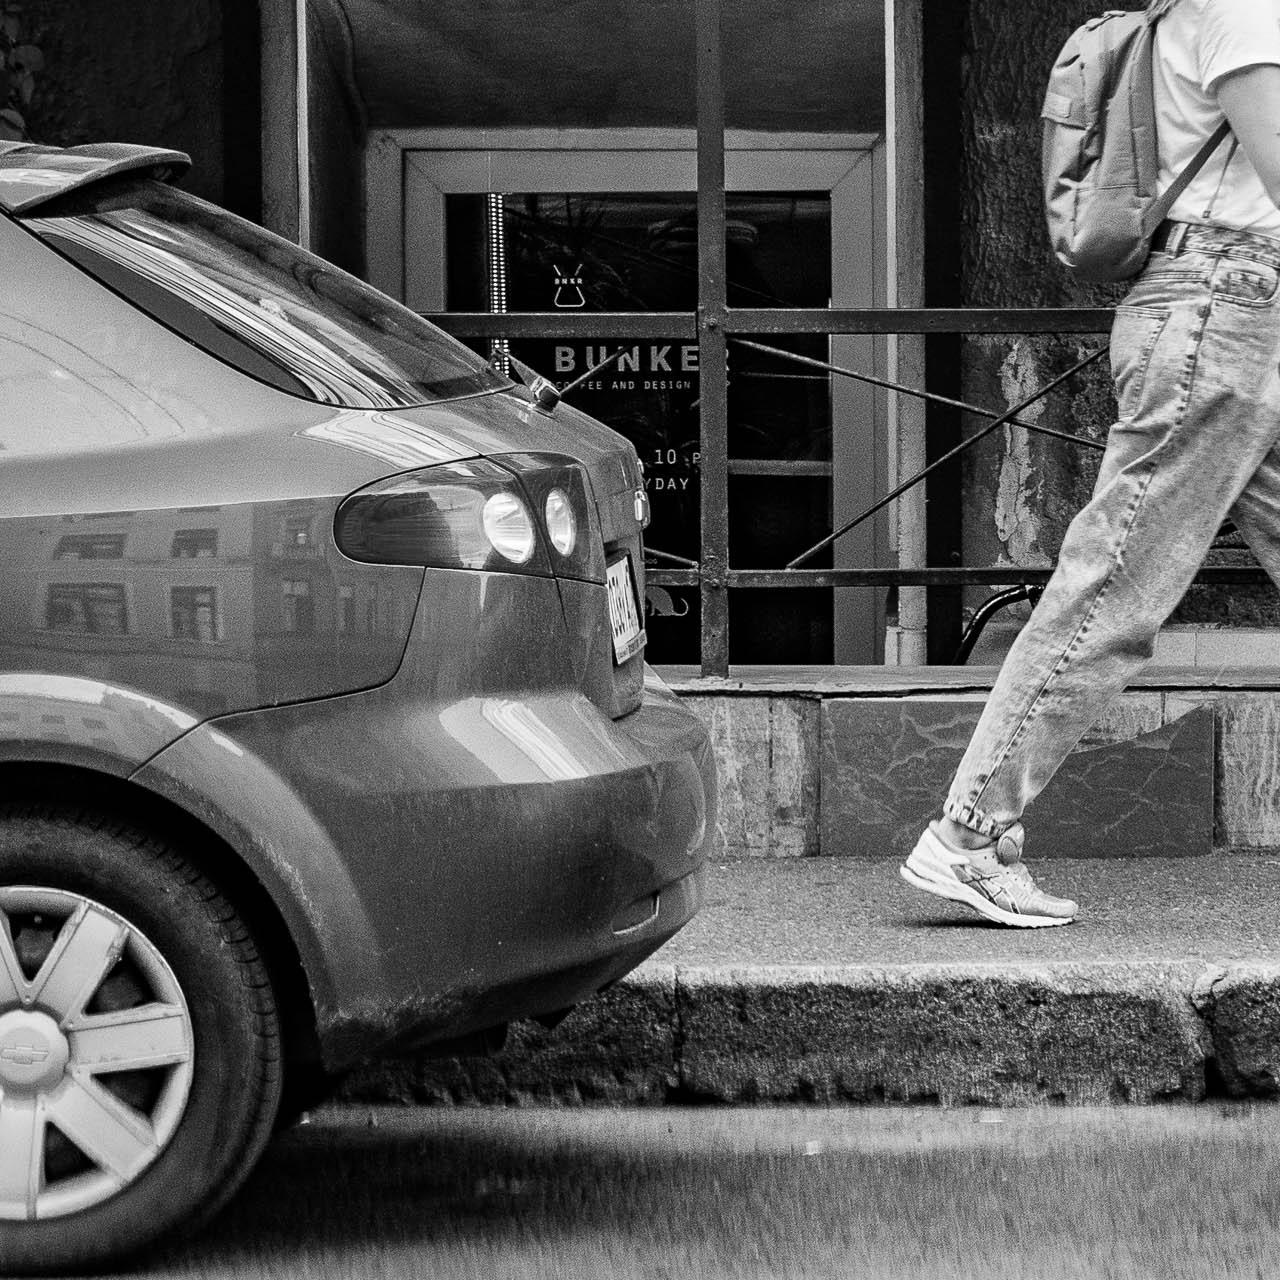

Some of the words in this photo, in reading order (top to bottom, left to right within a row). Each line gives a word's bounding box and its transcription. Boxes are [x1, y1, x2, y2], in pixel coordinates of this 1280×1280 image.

[555, 345, 729, 372] BUNKE
[555, 380, 603, 390] COFEE
[611, 380, 635, 390] AND
[644, 380, 691, 390] DESIGN
